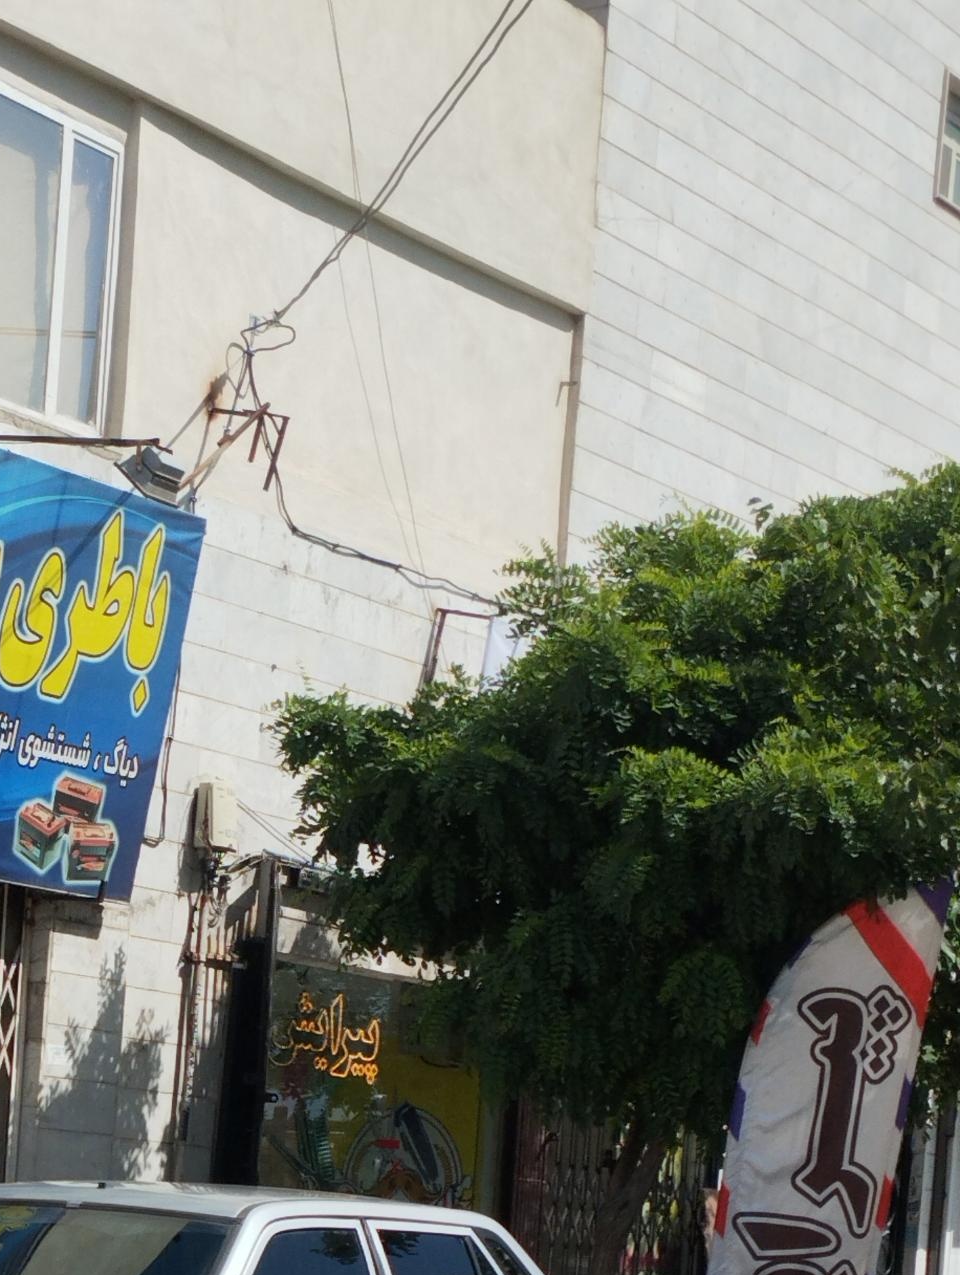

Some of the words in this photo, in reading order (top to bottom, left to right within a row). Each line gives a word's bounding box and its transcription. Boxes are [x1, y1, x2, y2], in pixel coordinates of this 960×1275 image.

[17, 724, 93, 770] شستشوی
[103, 736, 140, 786] دیاگ
[268, 991, 383, 1086] پیرایش
